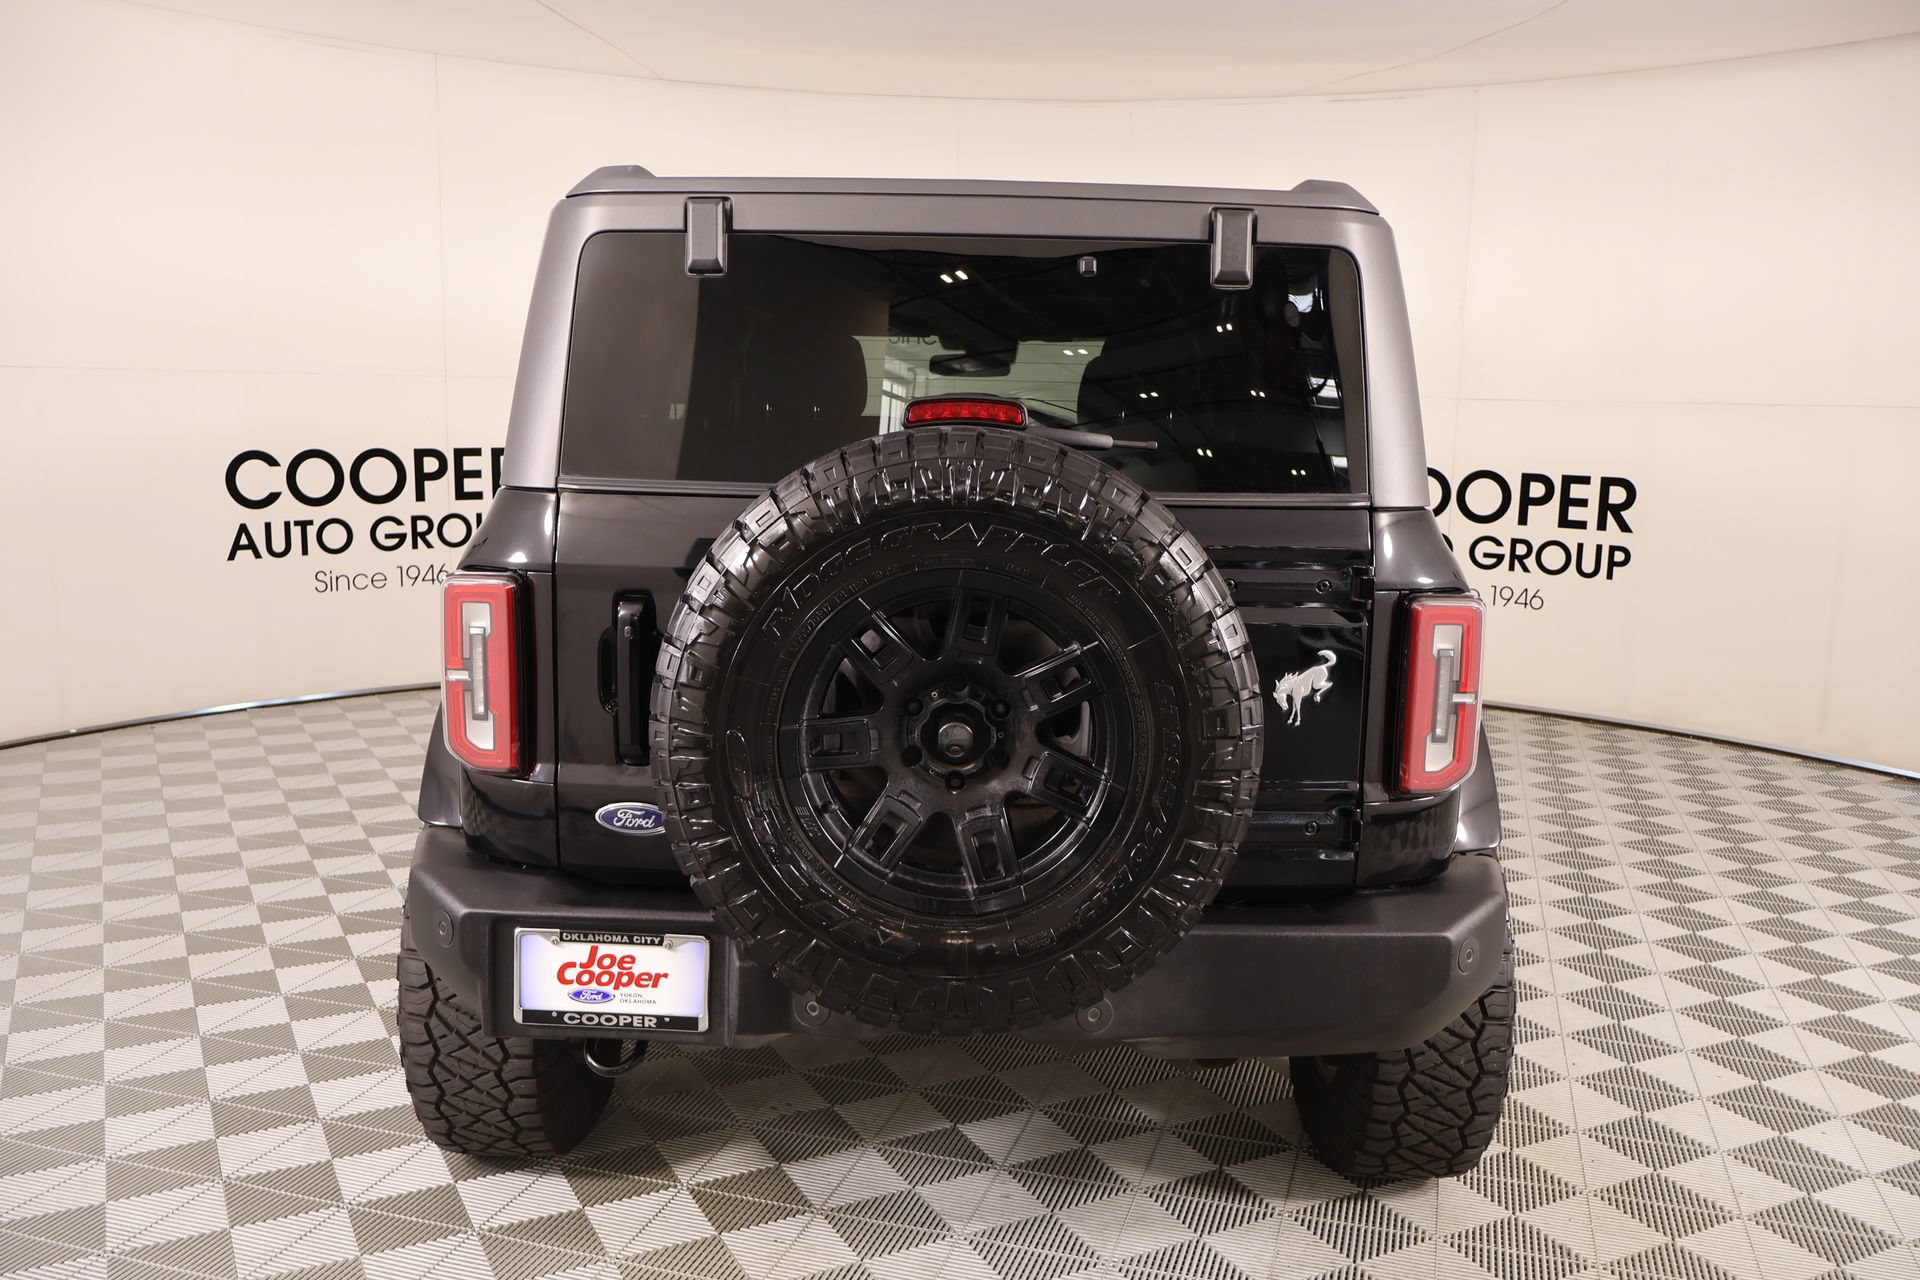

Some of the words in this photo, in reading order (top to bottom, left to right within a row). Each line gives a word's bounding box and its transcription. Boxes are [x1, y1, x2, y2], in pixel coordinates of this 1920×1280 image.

[227, 517, 354, 561] AUTO
[369, 512, 482, 552] GRO
[1468, 535, 1632, 580] GROUP
[314, 570, 388, 593] Since
[1490, 585, 1545, 610] 1946
[613, 808, 657, 829] Ford
[562, 932, 630, 944] OKLAHOMA
[633, 935, 661, 945] CITY
[579, 945, 636, 970] Joe
[557, 962, 668, 990] Cooper
[563, 1012, 657, 1028] COOPER
